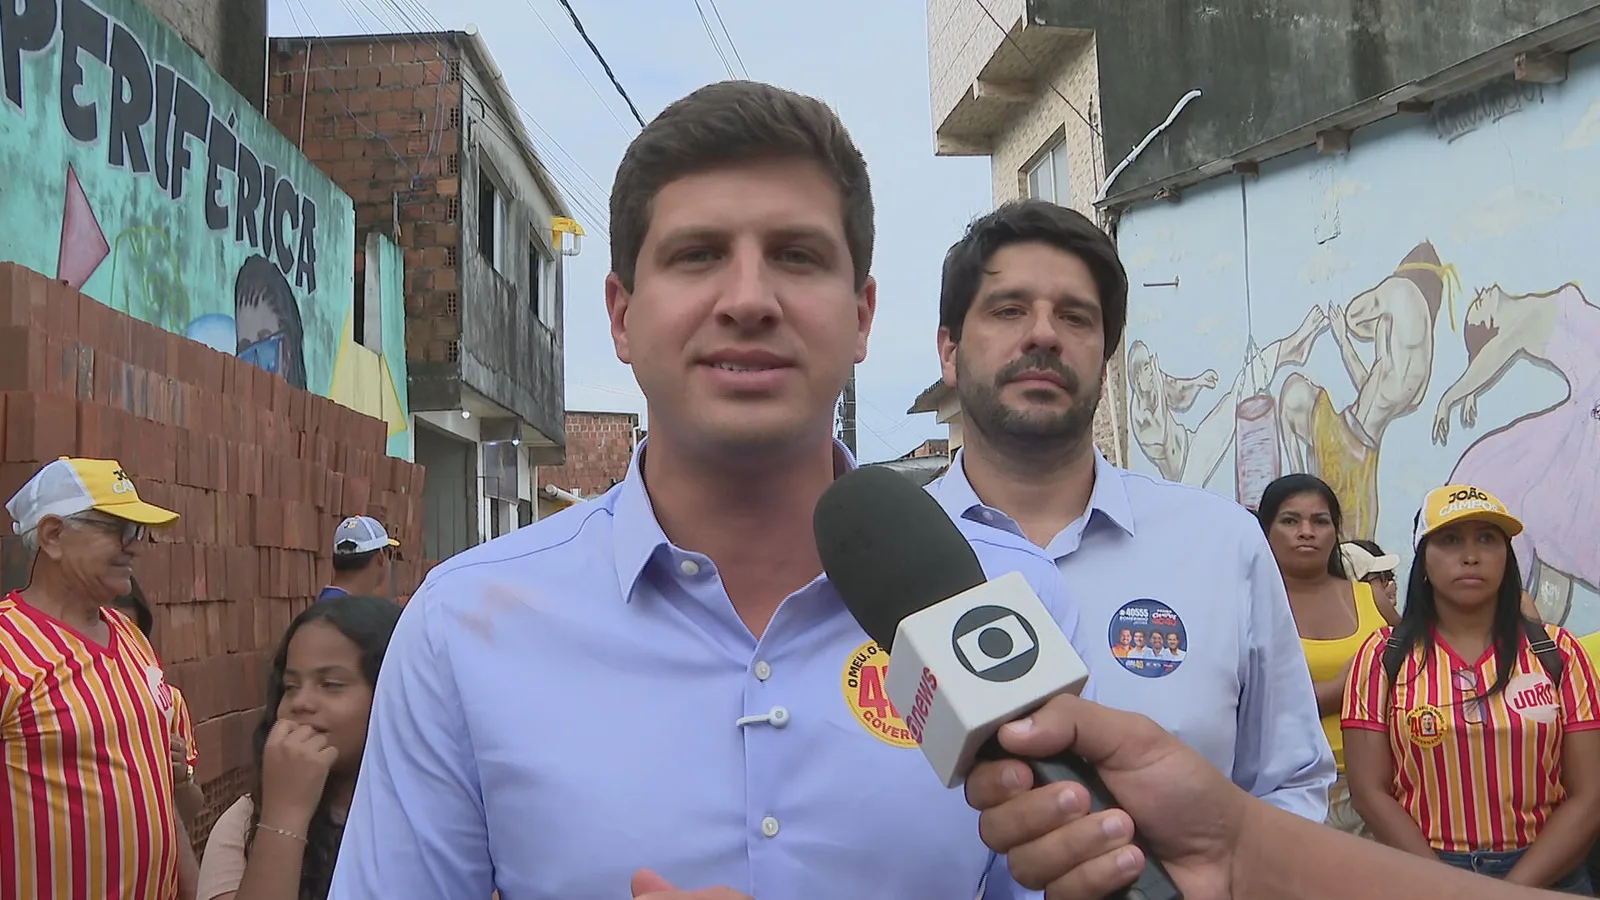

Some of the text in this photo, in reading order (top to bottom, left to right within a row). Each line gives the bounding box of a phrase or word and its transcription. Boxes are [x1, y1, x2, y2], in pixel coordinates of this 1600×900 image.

[1, 0, 316, 294] PERIFÉRICA
[1448, 487, 1488, 504] JOÃO
[859, 665, 901, 719] 4
